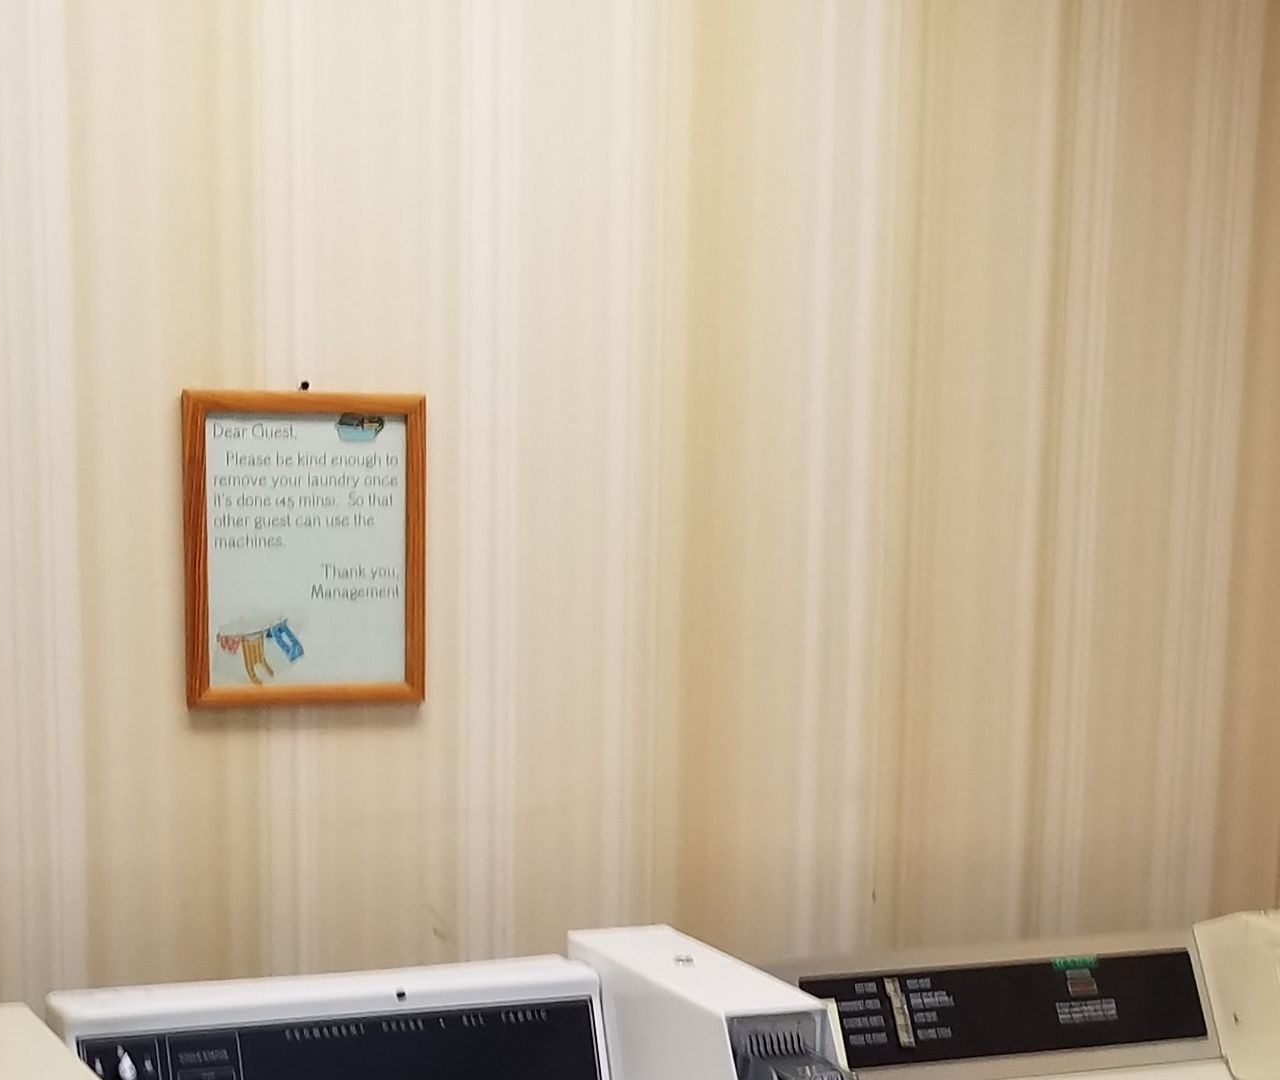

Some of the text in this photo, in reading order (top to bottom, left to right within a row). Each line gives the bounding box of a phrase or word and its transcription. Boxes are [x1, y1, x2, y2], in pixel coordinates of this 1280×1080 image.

[212, 423, 297, 441] Dear Guest,
[226, 451, 399, 469] Please be kind enough to
[213, 472, 398, 489] remove your laundry once
[213, 493, 233, 508] it's
[236, 493, 271, 508] done
[347, 491, 364, 508] So
[369, 492, 394, 508] that
[213, 512, 375, 530] other guest can use the
[214, 533, 285, 549] machines.
[321, 563, 399, 581] Thank you,
[311, 583, 399, 601] Management
